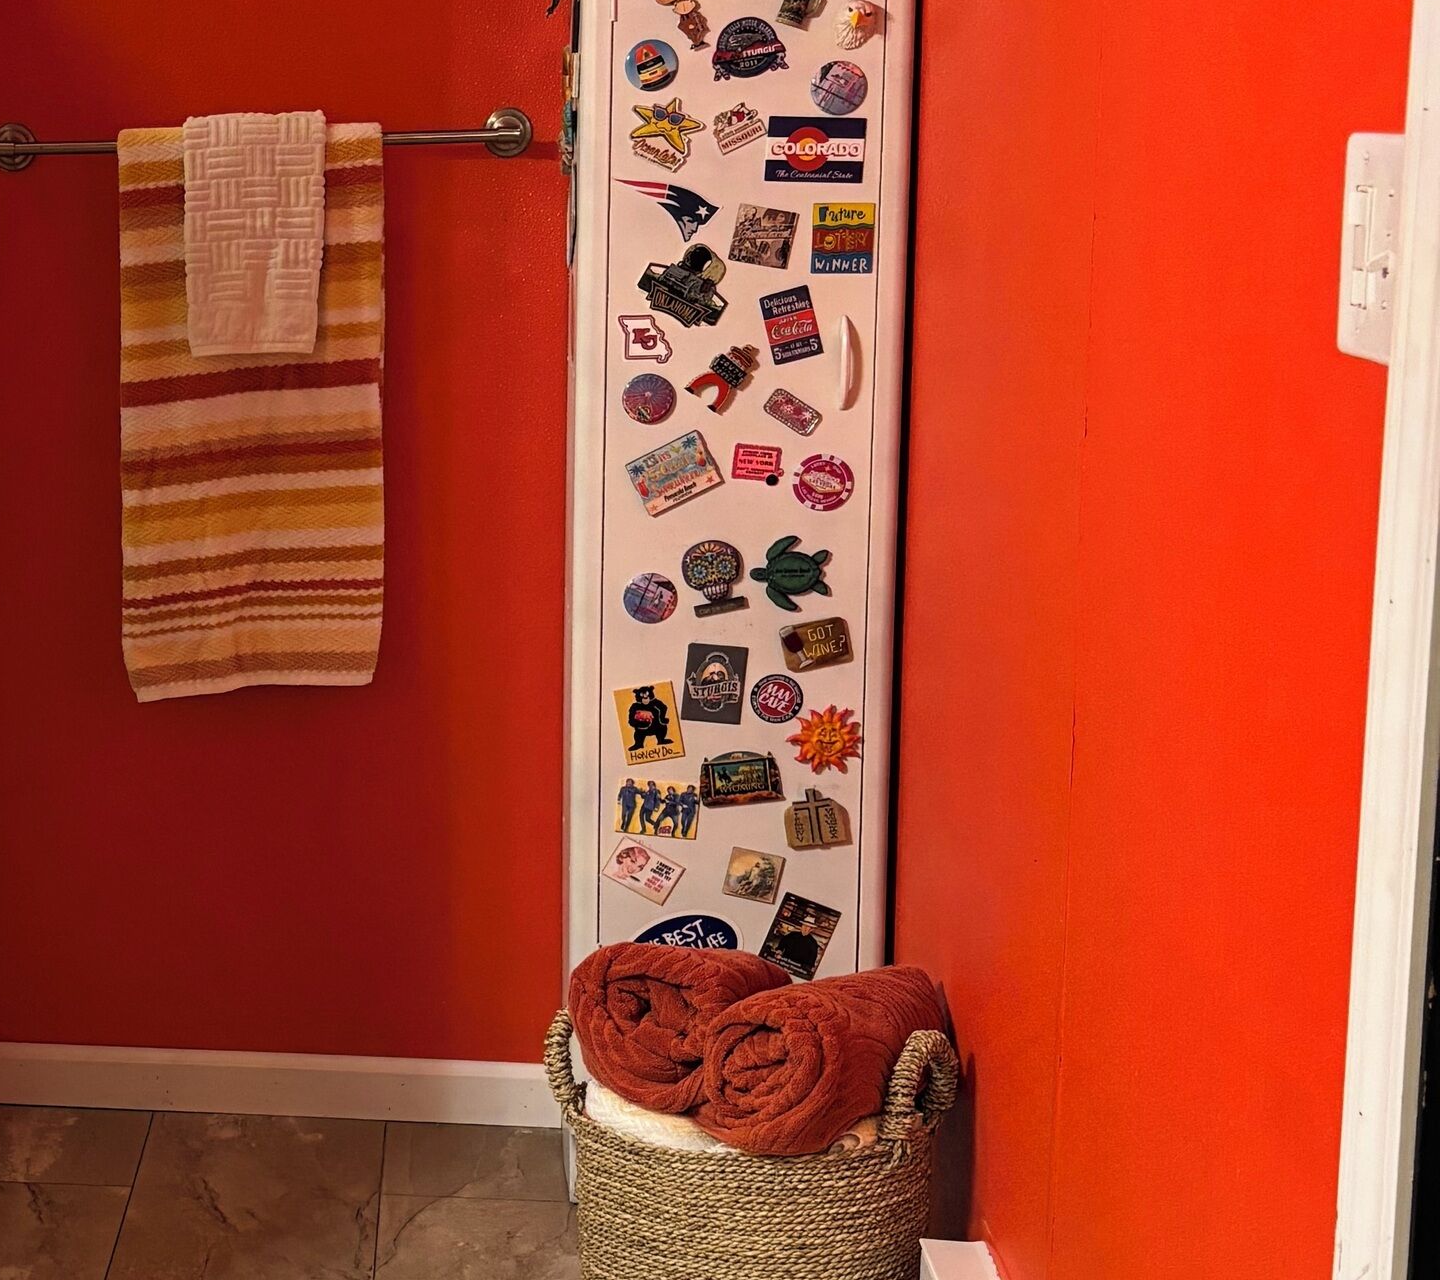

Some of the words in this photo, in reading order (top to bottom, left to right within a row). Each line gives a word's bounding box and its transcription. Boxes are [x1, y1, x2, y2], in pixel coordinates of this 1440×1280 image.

[742, 44, 781, 58] STURGIS
[721, 125, 763, 150] MISSOURI
[771, 141, 861, 158] COLORADO
[775, 169, 789, 178] The
[832, 169, 854, 179] State
[818, 206, 866, 222] Future
[814, 258, 868, 272] WINNER
[654, 289, 698, 321] OKLAHOMA
[763, 295, 797, 309] Delicious
[772, 300, 811, 316] Refreshing
[807, 624, 834, 642] GOT
[802, 634, 846, 658] WINE?
[693, 682, 738, 697] STURGIS
[761, 683, 795, 702] MAN
[759, 692, 790, 714] CAVE
[720, 782, 765, 793] WYOMING
[661, 918, 704, 947] BEST
